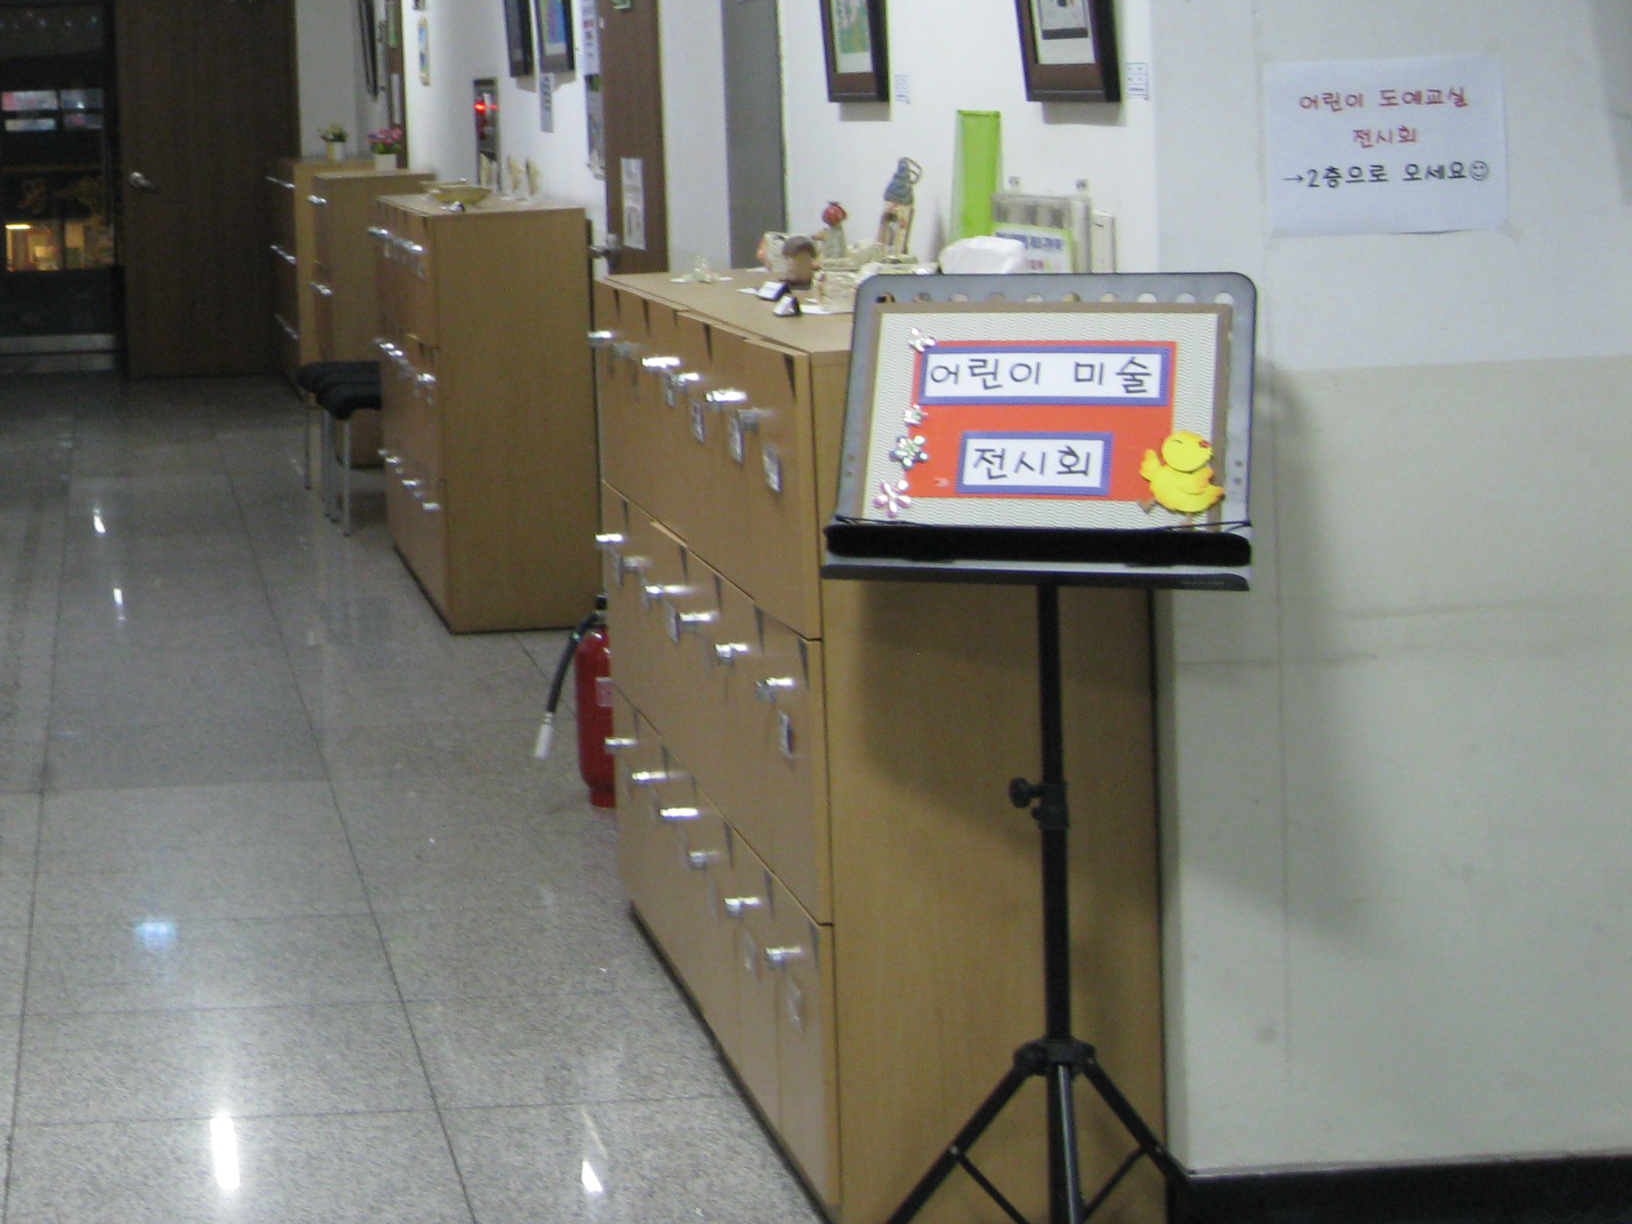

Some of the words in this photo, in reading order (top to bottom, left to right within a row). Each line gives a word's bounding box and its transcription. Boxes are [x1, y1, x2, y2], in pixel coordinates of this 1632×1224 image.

[1298, 91, 1365, 113] 어린이
[1378, 86, 1469, 108] 도예교실
[1352, 124, 1418, 150] 전시회
[1305, 163, 1391, 190] 2층으로
[1401, 160, 1468, 182] 오세요
[929, 357, 1042, 391] 어린이
[1074, 355, 1153, 395] 미술
[972, 443, 1092, 481] 전시회
